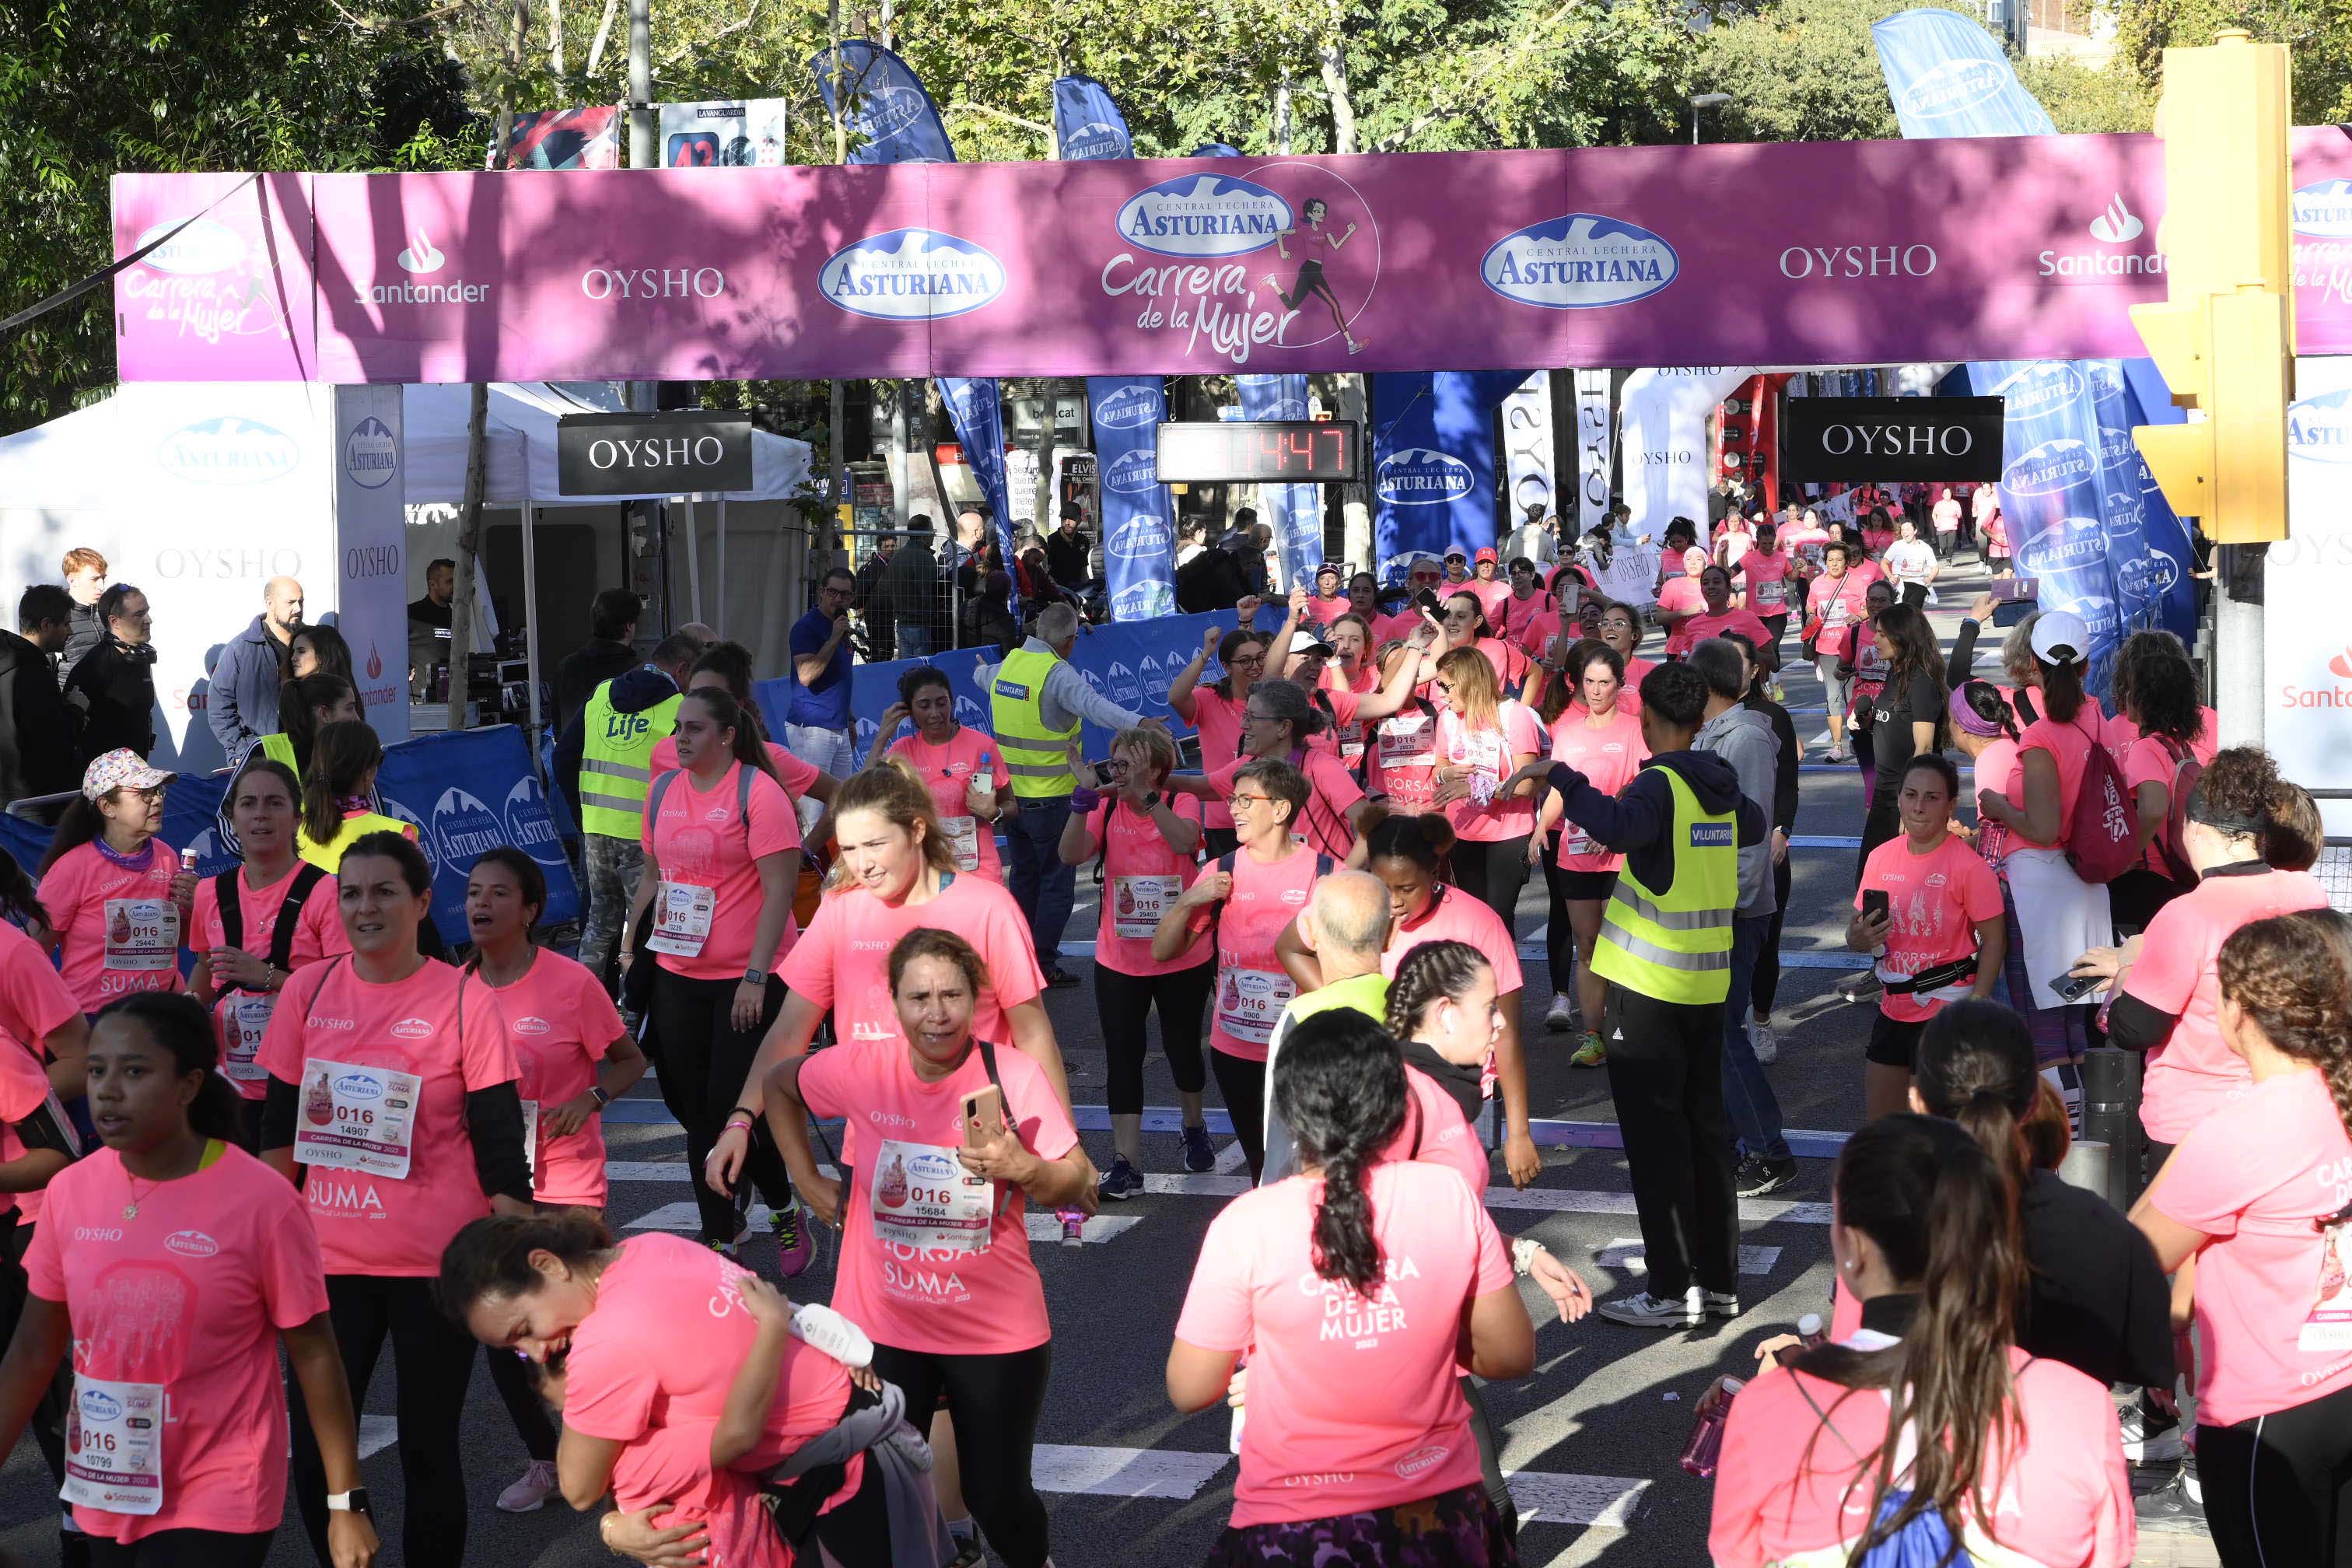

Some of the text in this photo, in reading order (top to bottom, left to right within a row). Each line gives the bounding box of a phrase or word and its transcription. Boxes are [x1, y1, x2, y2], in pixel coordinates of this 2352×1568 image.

[1218, 201, 1274, 210] LECHERA
[1129, 205, 1279, 236] ASTURIANA
[1527, 245, 1657, 257] CENTRAL LECHERA
[1496, 250, 1663, 285] ASTURIANA
[1780, 244, 1937, 279] OYSHO
[2039, 250, 2168, 276] Santand
[581, 268, 724, 299] OYSHO
[833, 263, 990, 296] ASTURIANA
[1101, 253, 1246, 296] Carrera
[355, 281, 489, 304] Santander
[1136, 291, 1300, 364] de la Mujer
[1822, 425, 1972, 456] OYSHO
[349, 443, 394, 471] ASTURIANA
[588, 436, 723, 469] OYSHO
[1248, 431, 1343, 471] 14:47
[1633, 450, 1692, 465] OYSHO
[1072, 464, 1096, 474] ELVIS
[1379, 470, 1467, 493] ASTURIANA
[156, 548, 302, 579] OYSHO
[348, 544, 398, 579] OYSHO
[1617, 553, 1650, 582] OYSHO
[606, 712, 649, 741] Life
[1387, 776, 1436, 792] DORSAL
[439, 824, 502, 859] ASTURIANA
[100, 876, 131, 892] OYSHO
[1137, 900, 1160, 909] 016
[668, 910, 686, 923] 016
[133, 926, 159, 937] 016
[1220, 948, 1239, 968] TU
[101, 971, 159, 993] SUMA
[1241, 997, 1266, 1010] 016
[307, 1016, 355, 1031] OYSHO
[243, 1029, 261, 1042] 01
[338, 1082, 380, 1096] ASTURIANA
[337, 1106, 374, 1124] 016
[870, 1111, 915, 1129] OYSHO
[341, 1125, 369, 1137] 14907
[310, 1134, 342, 1144] CARRERA
[362, 1141, 382, 1152] MUJER
[306, 1148, 342, 1160] OYSHO
[367, 1157, 401, 1169] Santander
[911, 1161, 954, 1176] ASTURIANA
[309, 1180, 383, 1209] SUMA
[911, 1187, 951, 1204] 016
[915, 1206, 946, 1216] 15684
[885, 1215, 916, 1226] CARRERA
[75, 1227, 122, 1242] OYSHO
[884, 1227, 917, 1241] OYSHO
[946, 1233, 982, 1242] Santander
[884, 1261, 967, 1296] SUMA
[1325, 1293, 1358, 1318] DE
[1319, 1308, 1407, 1342] MUJER
[83, 1430, 116, 1452] 016
[86, 1454, 112, 1468] 10799
[114, 1492, 152, 1504] Santander
